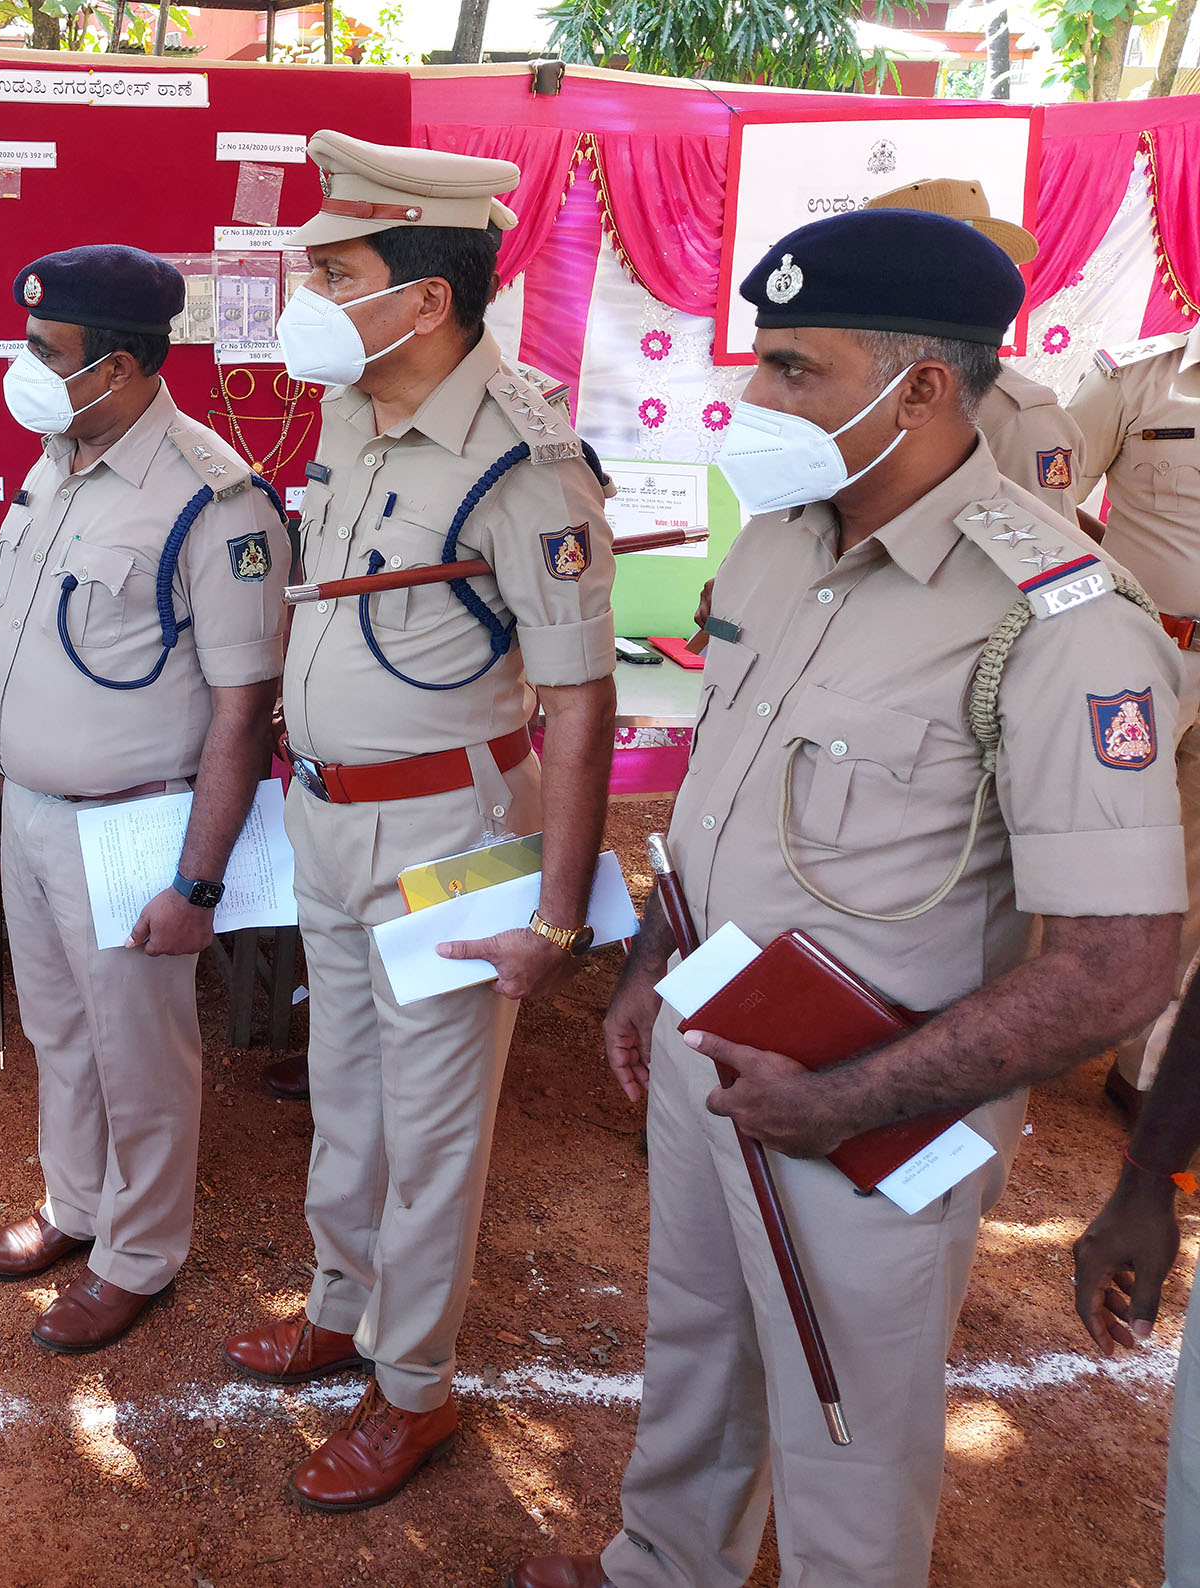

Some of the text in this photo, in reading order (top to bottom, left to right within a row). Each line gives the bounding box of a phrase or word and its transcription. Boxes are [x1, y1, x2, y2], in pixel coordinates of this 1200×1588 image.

[158, 81, 192, 97] ಠಾಣೆ
[238, 144, 268, 152] 124/2020
[808, 460, 827, 470] N95
[738, 989, 766, 1013] 2021
